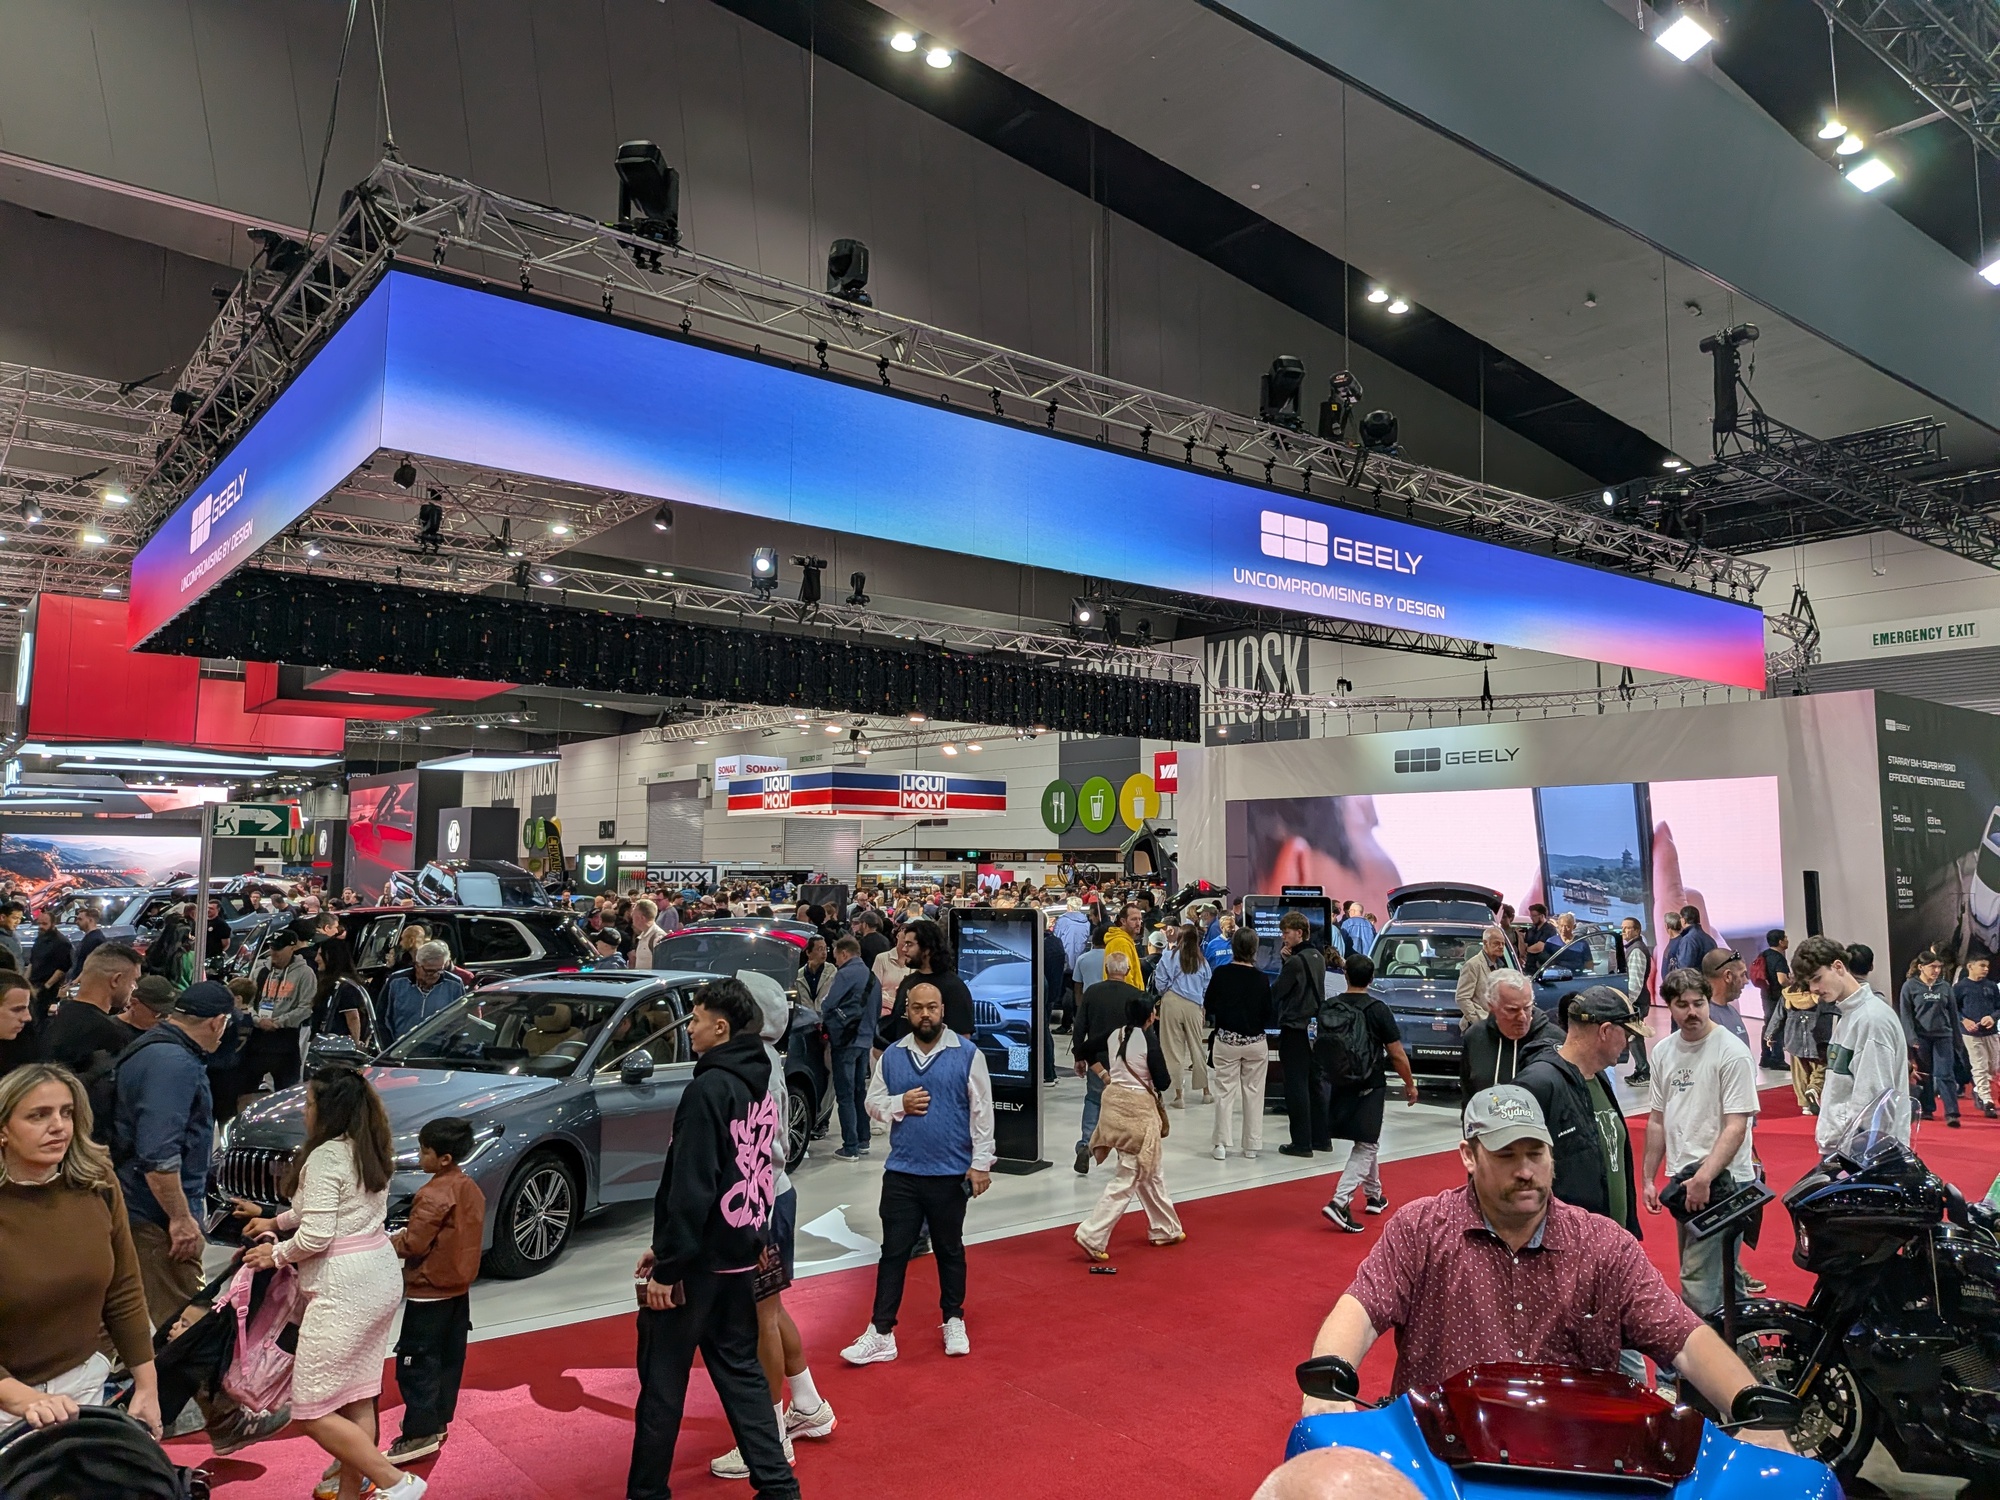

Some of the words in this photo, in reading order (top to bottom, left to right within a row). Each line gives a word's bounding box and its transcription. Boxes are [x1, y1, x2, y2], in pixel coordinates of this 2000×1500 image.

[211, 467, 248, 525] GEELY
[180, 544, 223, 593] UNCOMPROMISING
[222, 537, 231, 558] BY
[231, 517, 254, 551] DESIGN
[1333, 536, 1423, 575] GEELY
[1233, 567, 1371, 606] UNCOMPROMISING
[1374, 593, 1394, 610] BY
[1396, 598, 1446, 620] DESIGN
[1872, 626, 1943, 646] EMERGENCY
[1948, 622, 1976, 638] EXIT
[1207, 631, 1308, 727] KIOSK
[1445, 747, 1520, 765] GEELY
[717, 764, 738, 775] SONAX
[1922, 760, 1937, 770] SUPER
[1937, 762, 1956, 773] HYBRID
[765, 775, 790, 792] LIQUI
[903, 775, 944, 792] LIQUI
[1888, 772, 1916, 784] EFFICIENCY
[1917, 776, 1933, 786] MEETS
[1933, 778, 1966, 790] INTELLIGENCE
[765, 792, 790, 809] MOLY
[903, 792, 944, 809] MOLY
[1892, 814, 1904, 823] 943
[647, 871, 709, 883] QUIXX
[1500, 1106, 1535, 1121] Sydney
